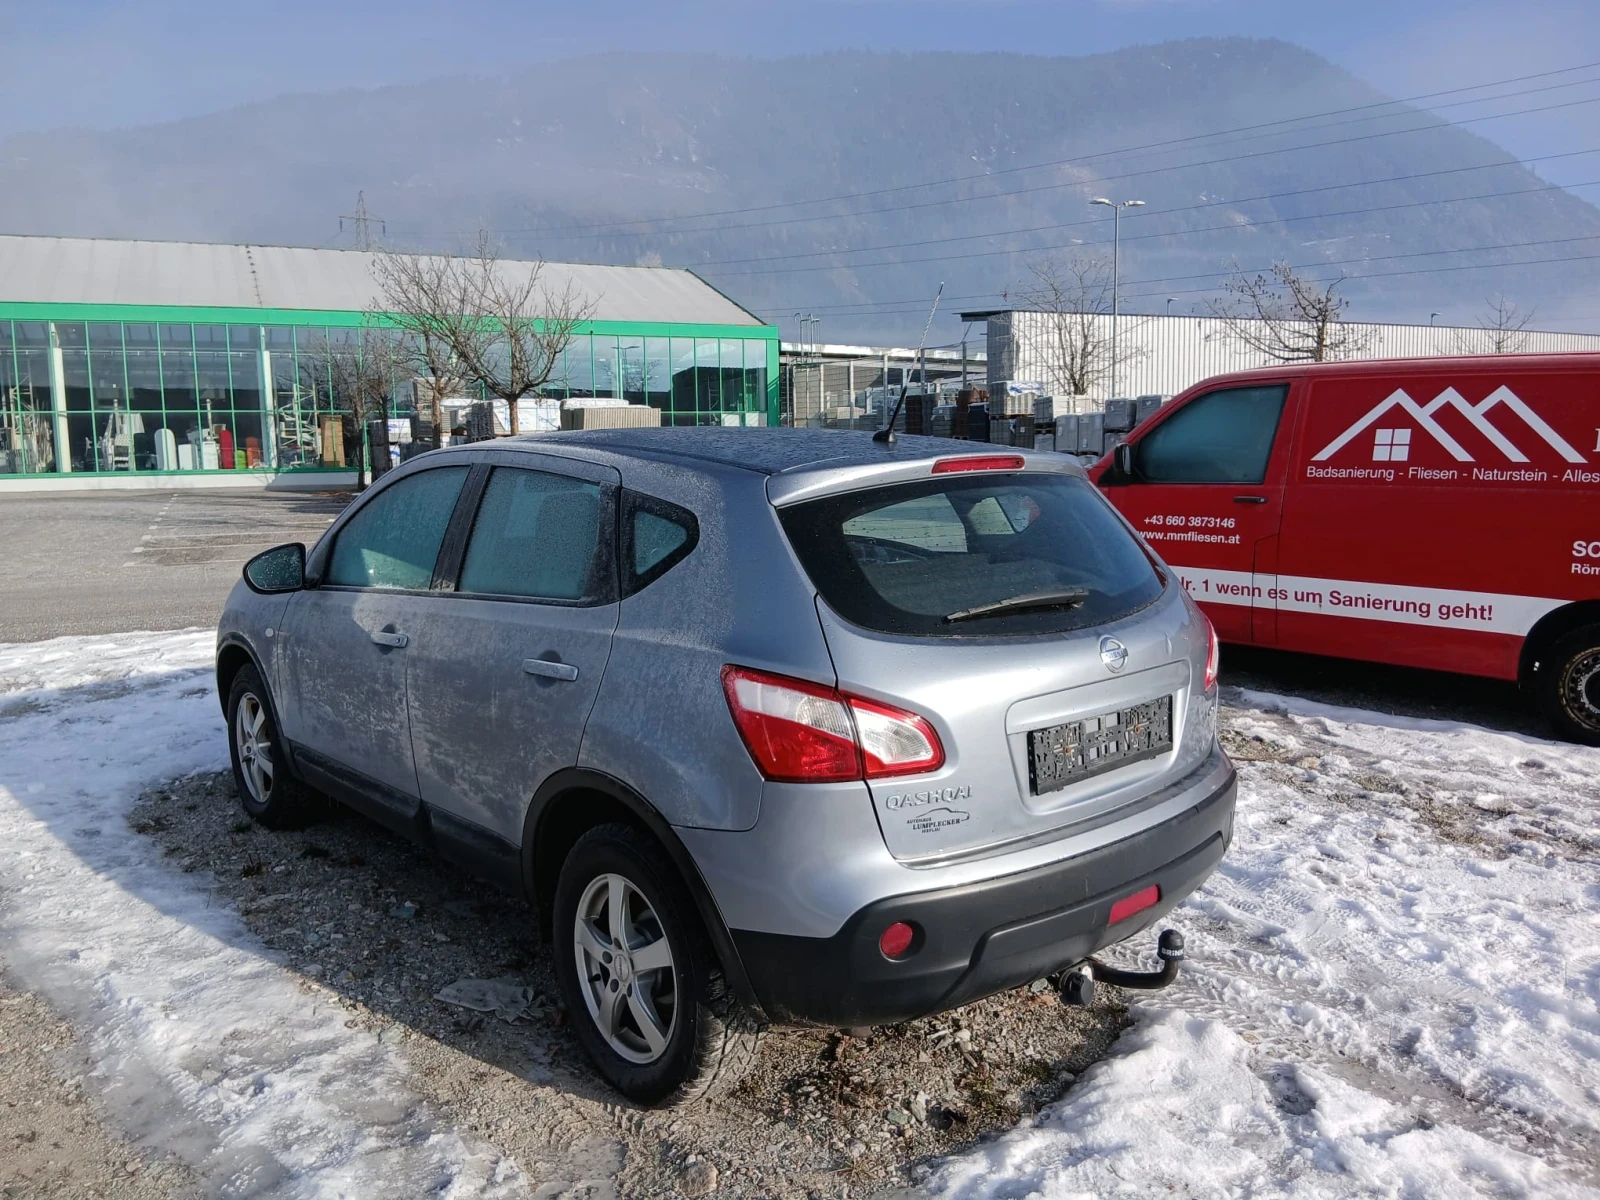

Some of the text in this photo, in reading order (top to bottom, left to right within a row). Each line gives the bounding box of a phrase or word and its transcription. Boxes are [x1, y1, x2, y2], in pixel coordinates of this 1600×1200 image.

[1306, 466, 1394, 481] Badsanierung
[1408, 467, 1457, 479] Fliesen
[1472, 468, 1547, 481] Naturstein
[1562, 469, 1600, 482] Alles
[1144, 515, 1235, 528] +43 660 3873146
[1202, 579, 1209, 592] 1
[1216, 583, 1262, 597] wenn
[1267, 588, 1288, 600] es
[1294, 591, 1323, 604] um
[1328, 590, 1431, 618] Sanierung
[1438, 603, 1493, 621] geht!
[886, 785, 972, 811] QASHQAI
